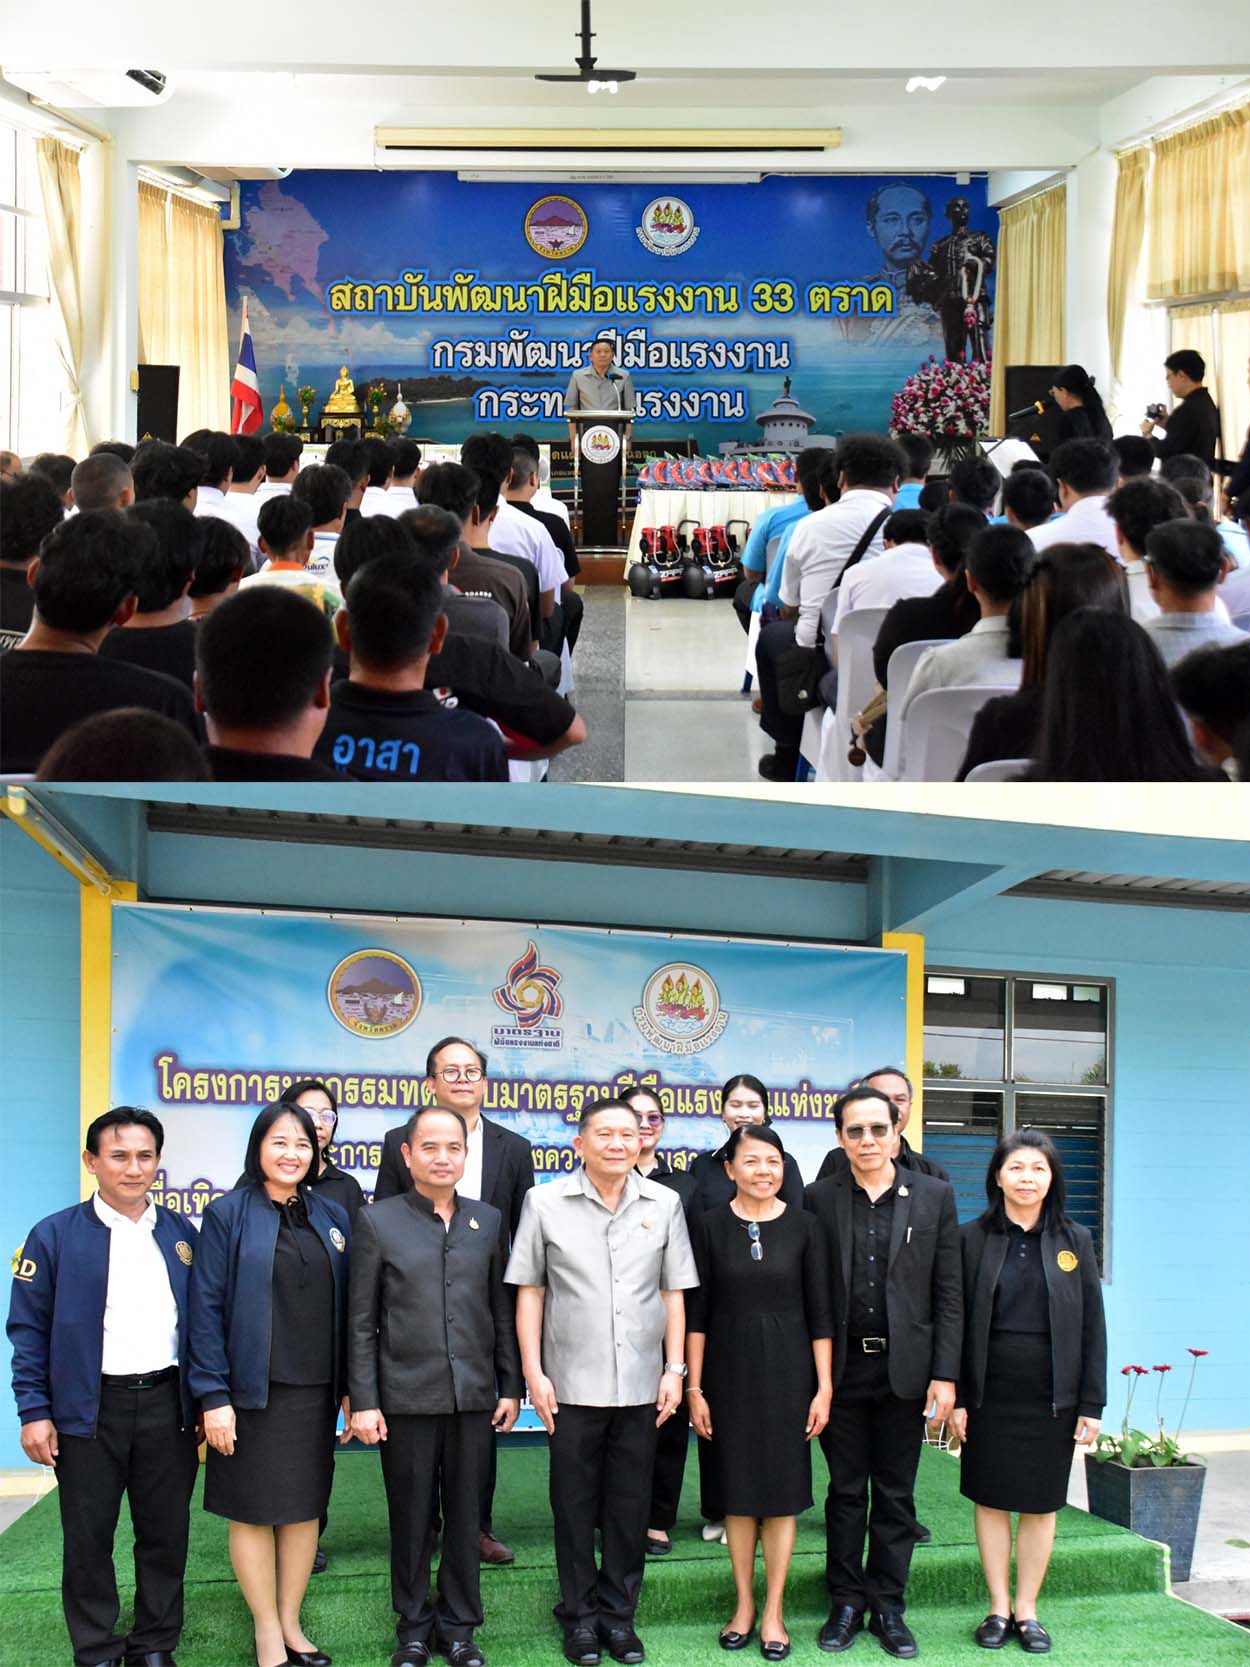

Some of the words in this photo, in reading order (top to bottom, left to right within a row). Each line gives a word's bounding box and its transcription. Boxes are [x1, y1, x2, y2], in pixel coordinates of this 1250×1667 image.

[329, 272, 738, 312] สถาบันพัฒนาฝีมือแรงงาน
[752, 282, 795, 312] 33
[808, 284, 893, 312] ตราด
